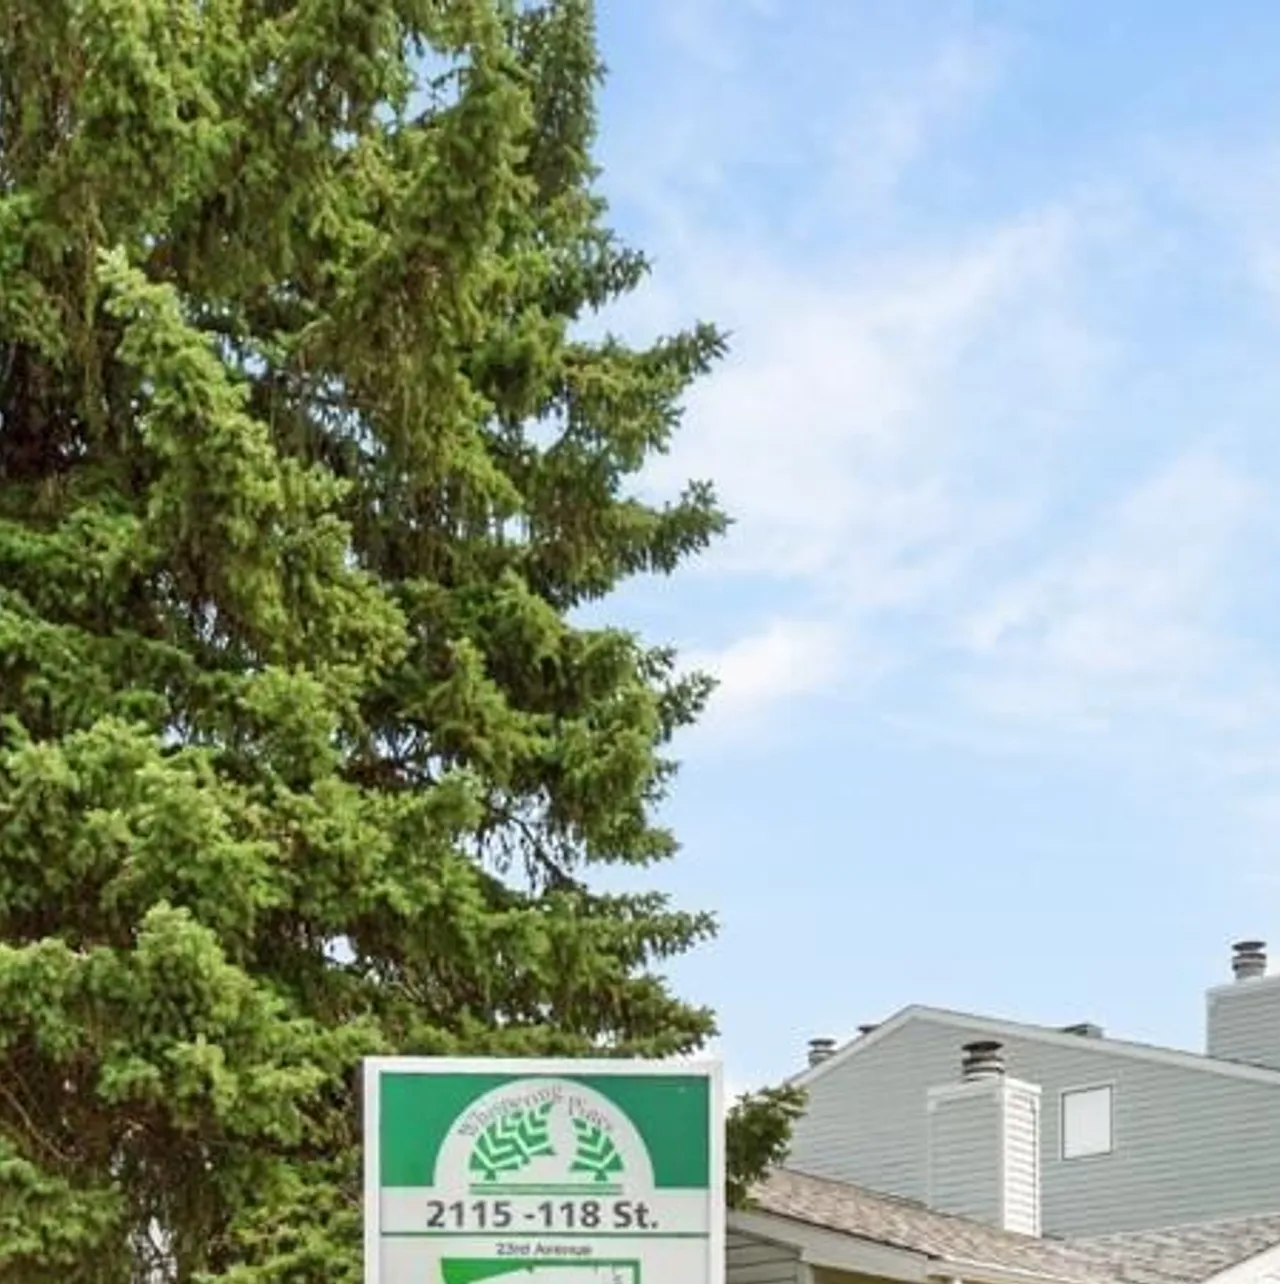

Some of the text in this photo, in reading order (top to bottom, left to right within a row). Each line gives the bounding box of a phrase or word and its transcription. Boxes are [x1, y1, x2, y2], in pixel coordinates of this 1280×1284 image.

[426, 1200, 512, 1228] 2115
[613, 1201, 659, 1229] St.
[495, 1242, 593, 1256] 23rd Avenue
